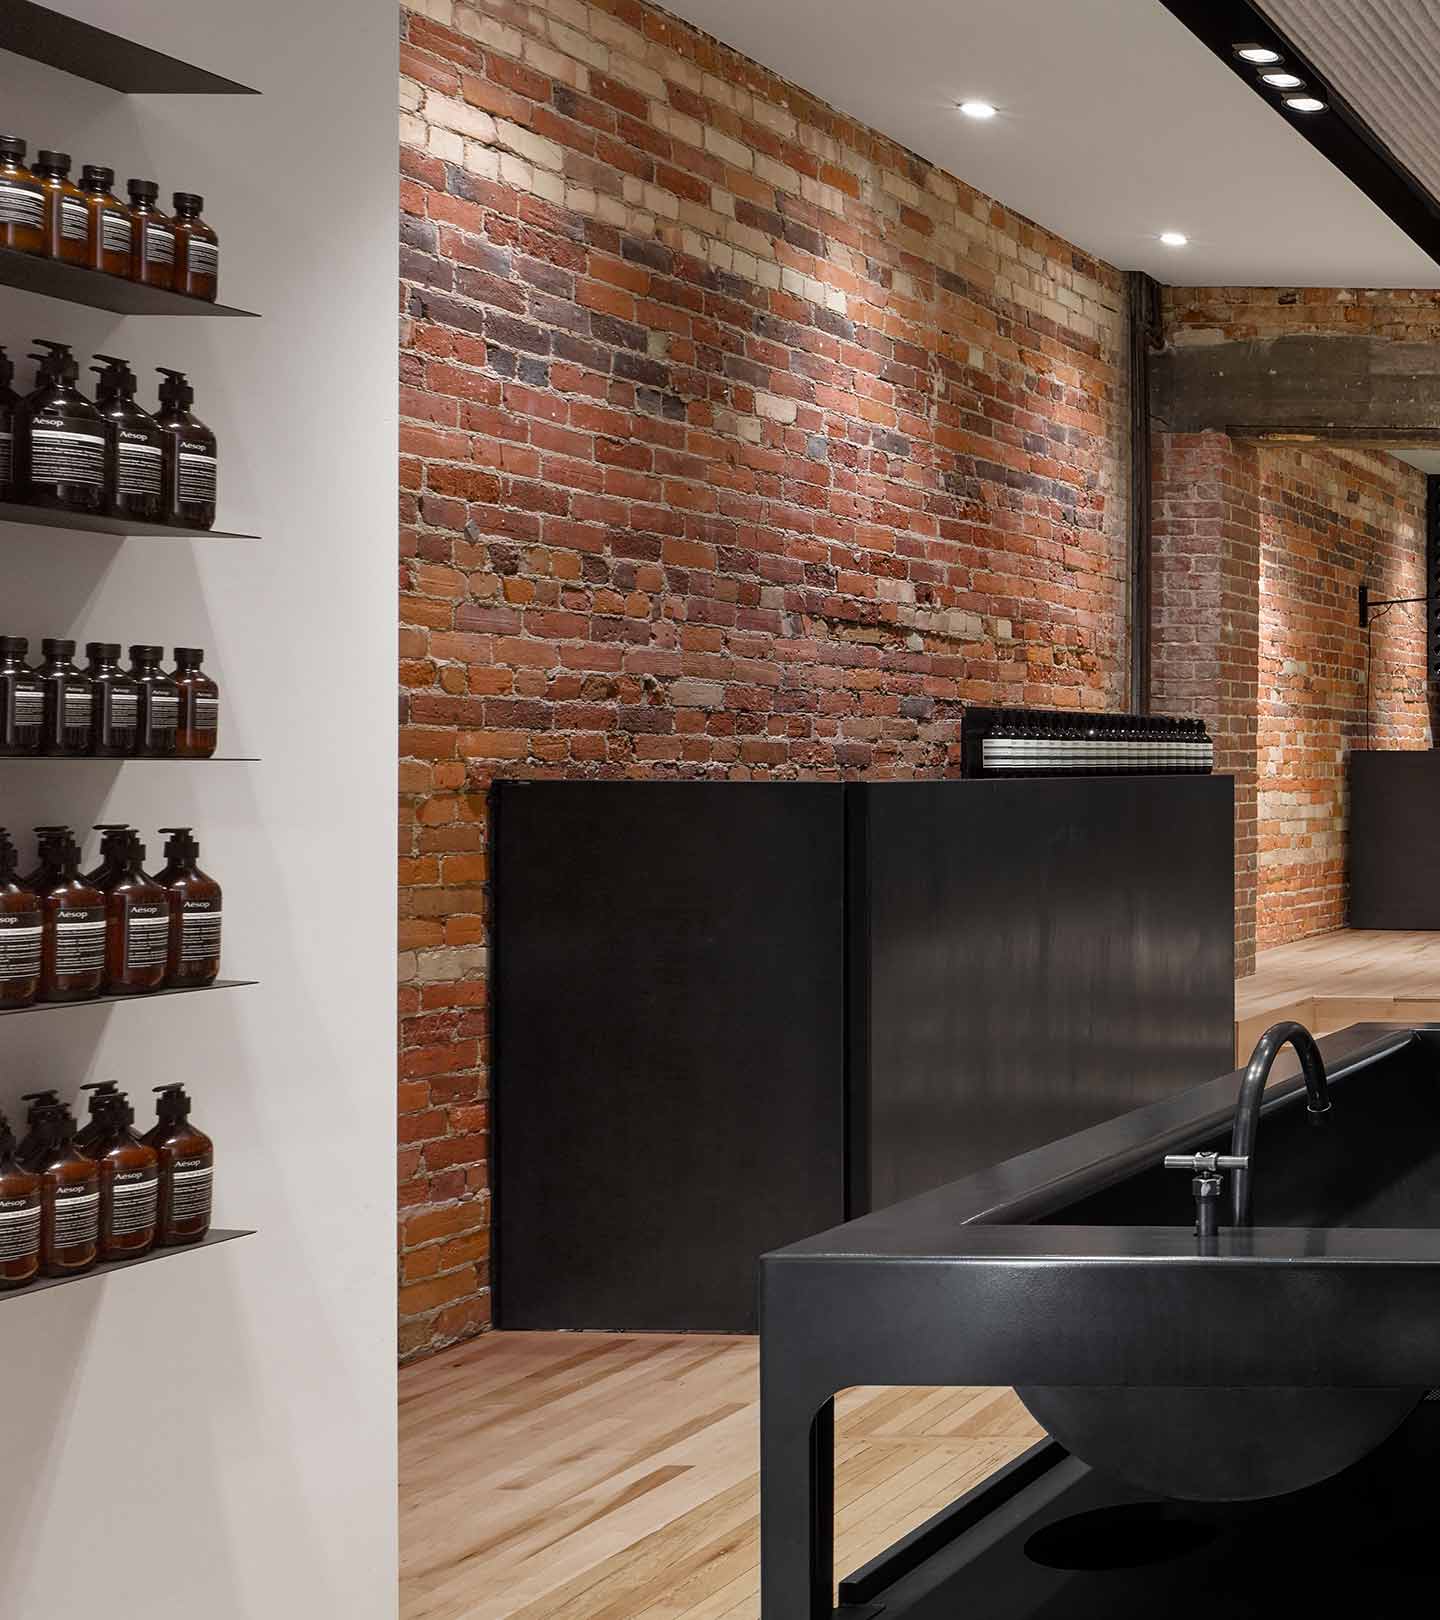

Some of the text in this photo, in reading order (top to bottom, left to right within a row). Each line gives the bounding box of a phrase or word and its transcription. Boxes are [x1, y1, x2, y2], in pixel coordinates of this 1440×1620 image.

[33, 417, 64, 427] Aesop
[119, 431, 148, 441] Aesop
[180, 441, 207, 452] Aesop
[130, 906, 158, 914] Aesop
[183, 901, 210, 910] Aesop
[57, 910, 89, 920] Aesop
[0, 916, 18, 925] sop
[175, 1159, 201, 1168] Aesop
[114, 1171, 143, 1181] Aesop
[56, 1185, 85, 1194] Aesop
